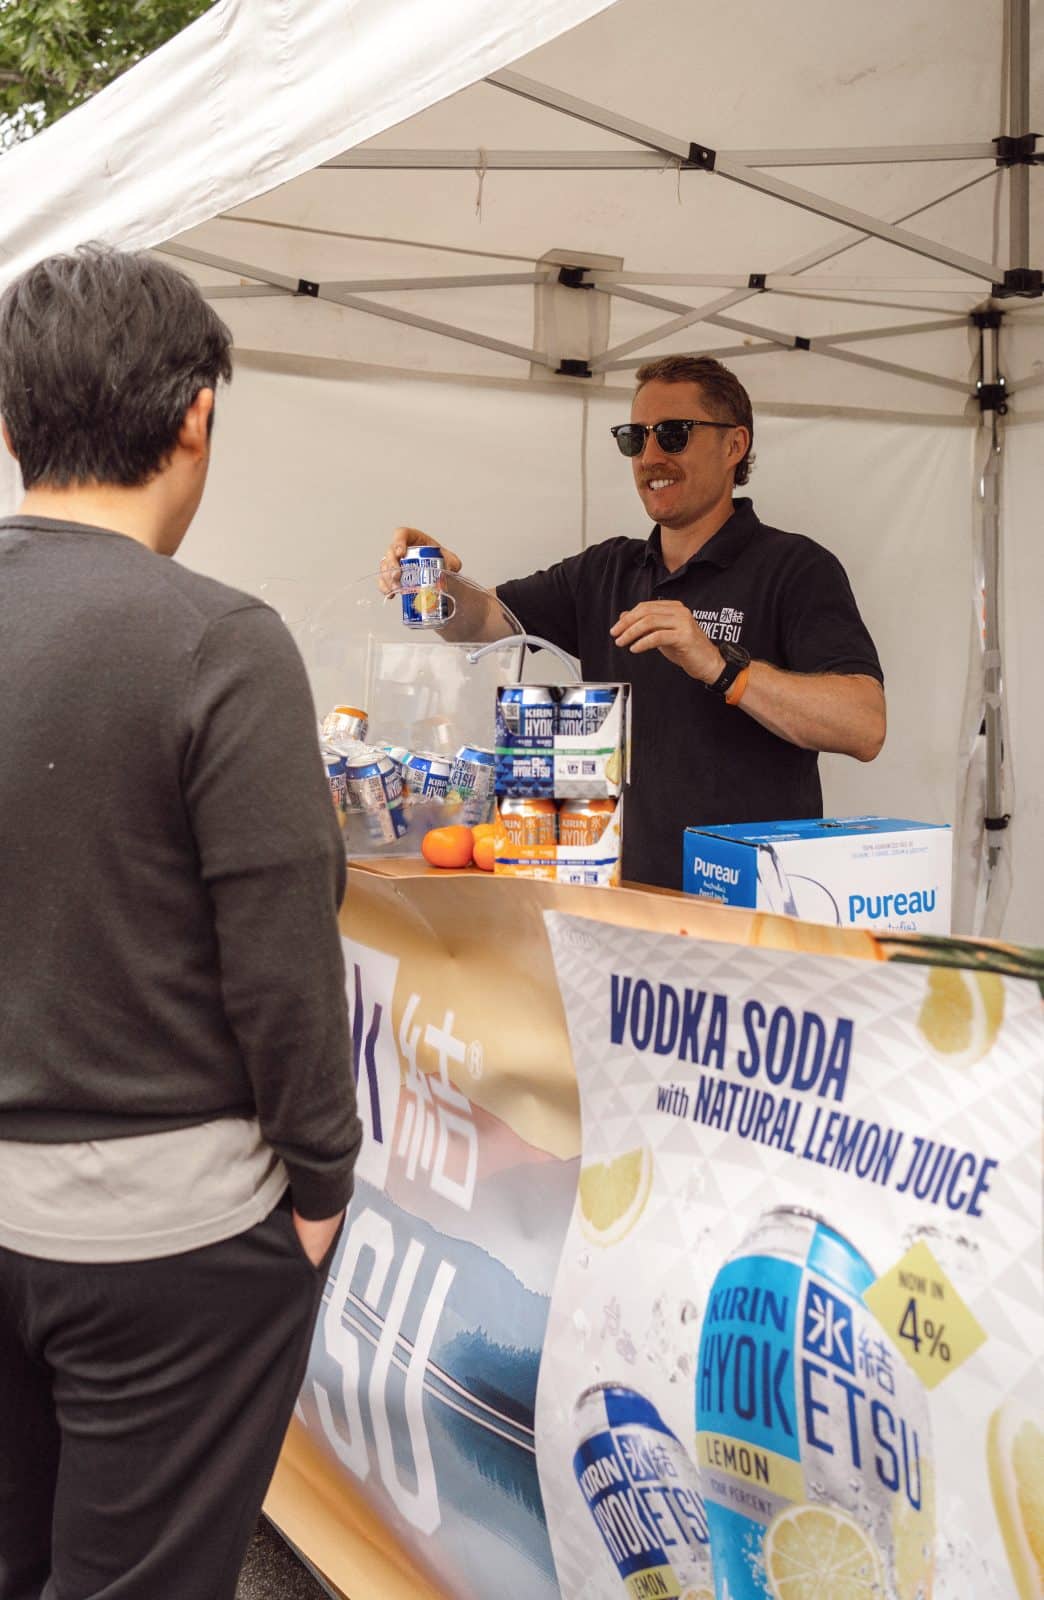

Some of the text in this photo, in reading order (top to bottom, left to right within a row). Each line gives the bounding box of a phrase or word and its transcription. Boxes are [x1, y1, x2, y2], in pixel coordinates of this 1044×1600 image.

[693, 609, 719, 621] KIRIN
[525, 708, 553, 718] KIRIN
[610, 973, 855, 1101] VODKA SODA
[657, 1076, 999, 1218] with NATURAL LEMON JUICE
[709, 1286, 789, 1333] KIRIN
[899, 1297, 951, 1363] 4%
[804, 1286, 895, 1397] 氷結
[580, 1454, 624, 1501] KIRIN
[706, 1438, 769, 1485] LEMON
[632, 1572, 669, 1600] LEMON
